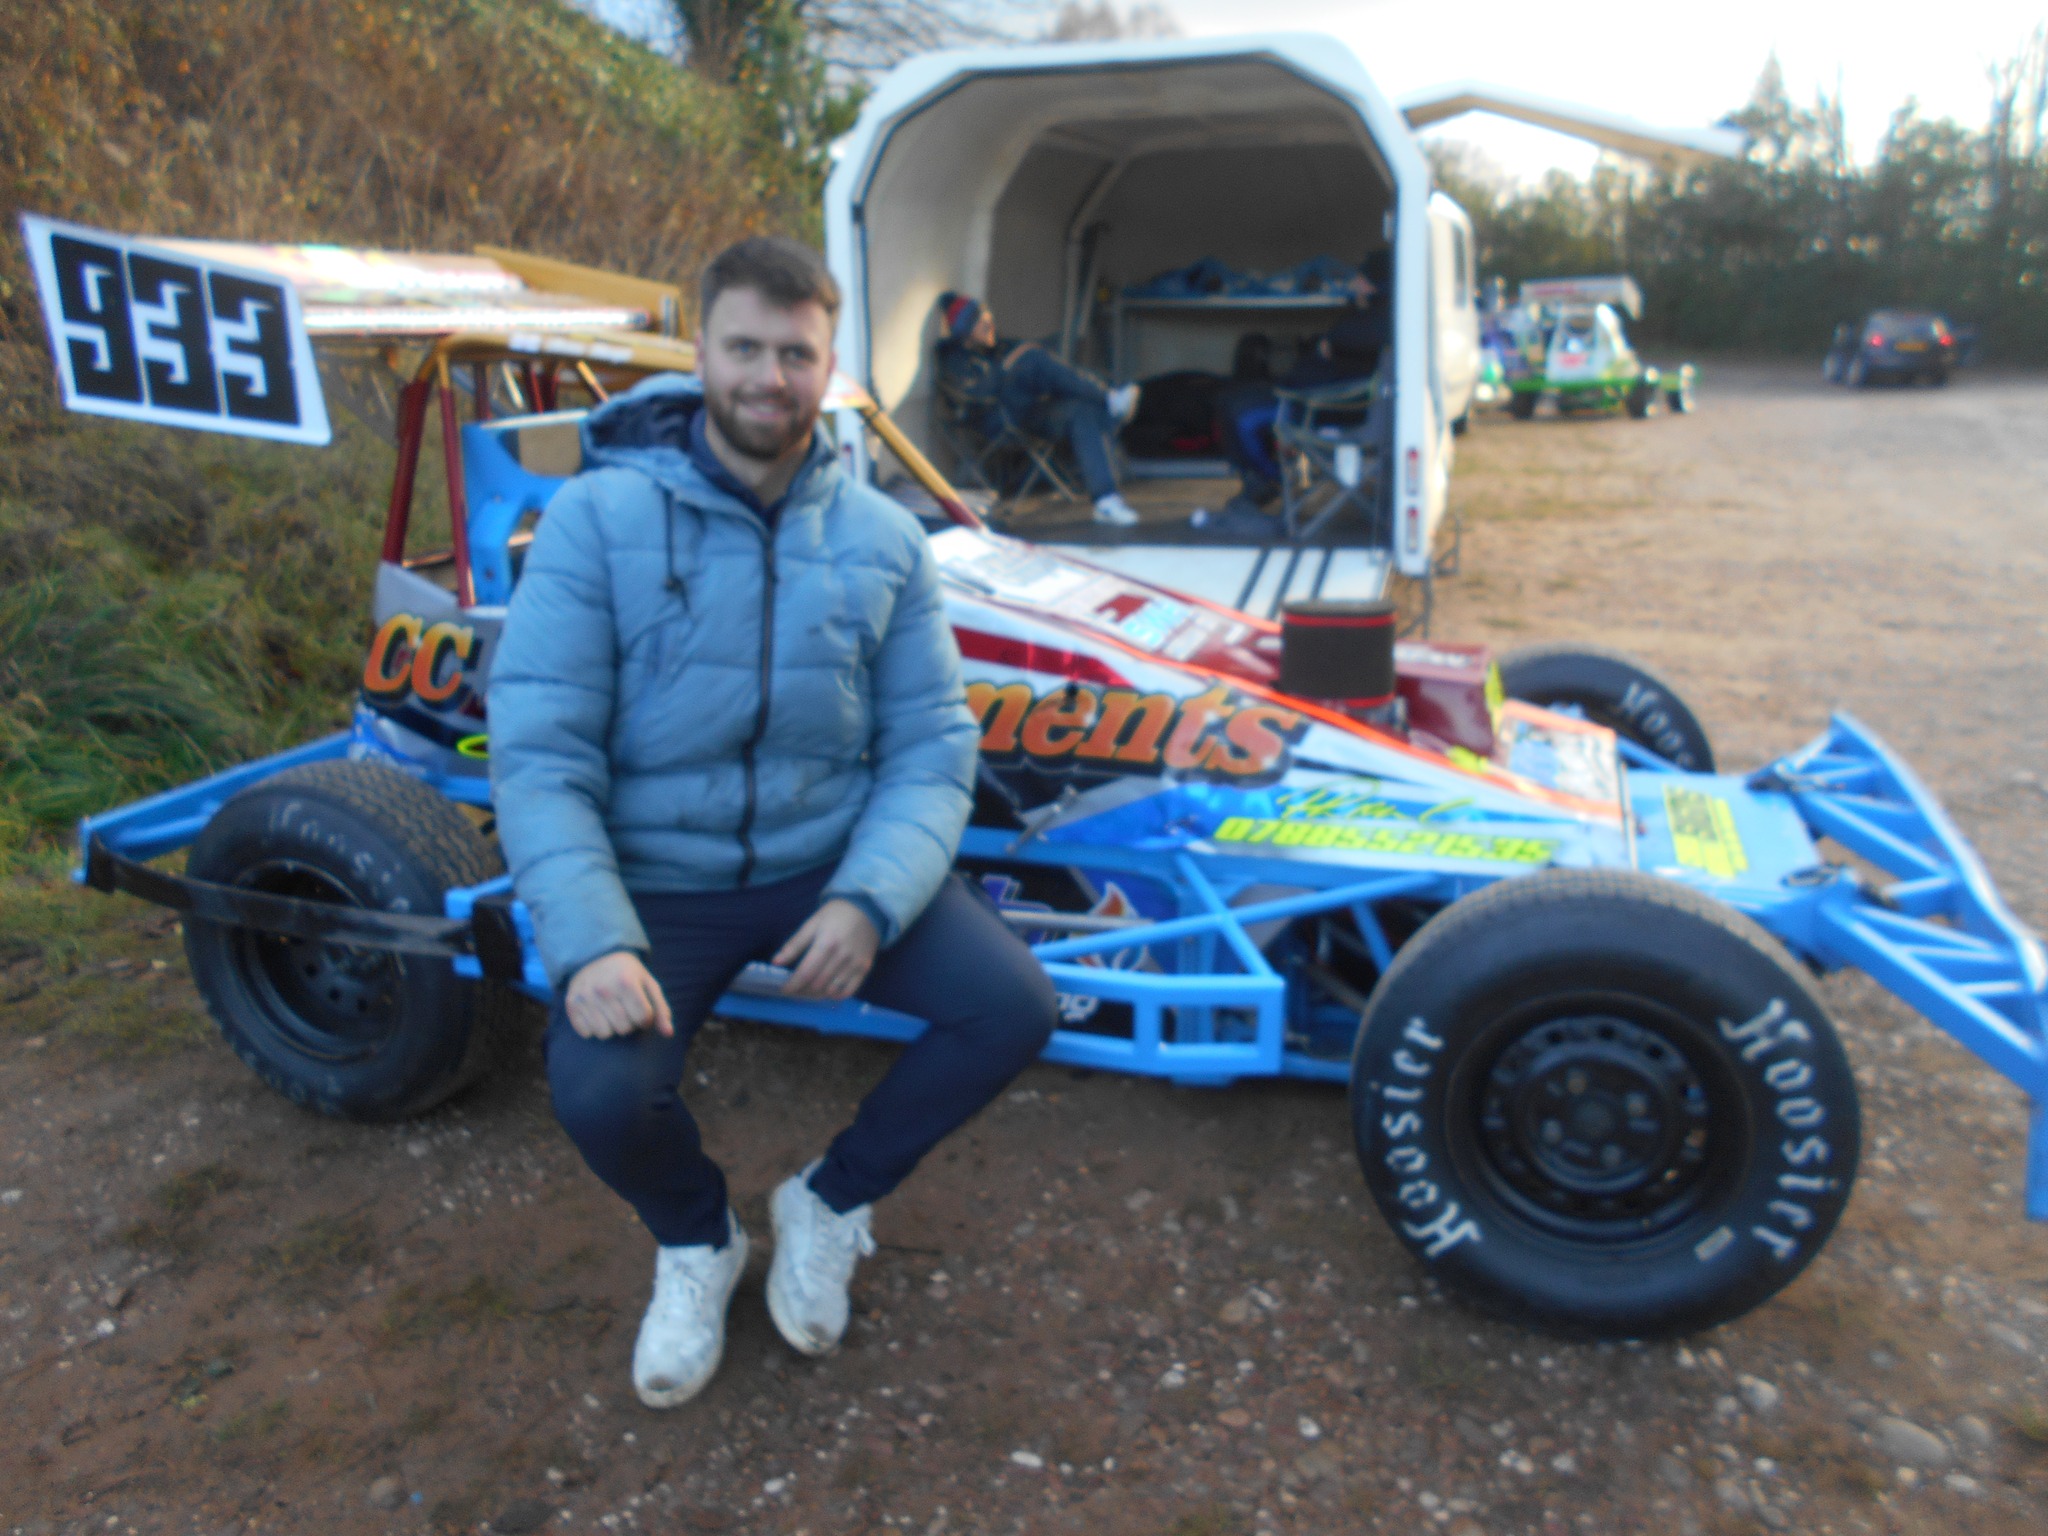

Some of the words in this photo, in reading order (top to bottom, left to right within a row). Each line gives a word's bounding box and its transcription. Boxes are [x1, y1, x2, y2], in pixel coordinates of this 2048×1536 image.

[50, 232, 301, 428] 933
[363, 612, 476, 704] CC
[1368, 1014, 1484, 1260] Hoosier
[1716, 997, 1840, 1261] Hoosier
